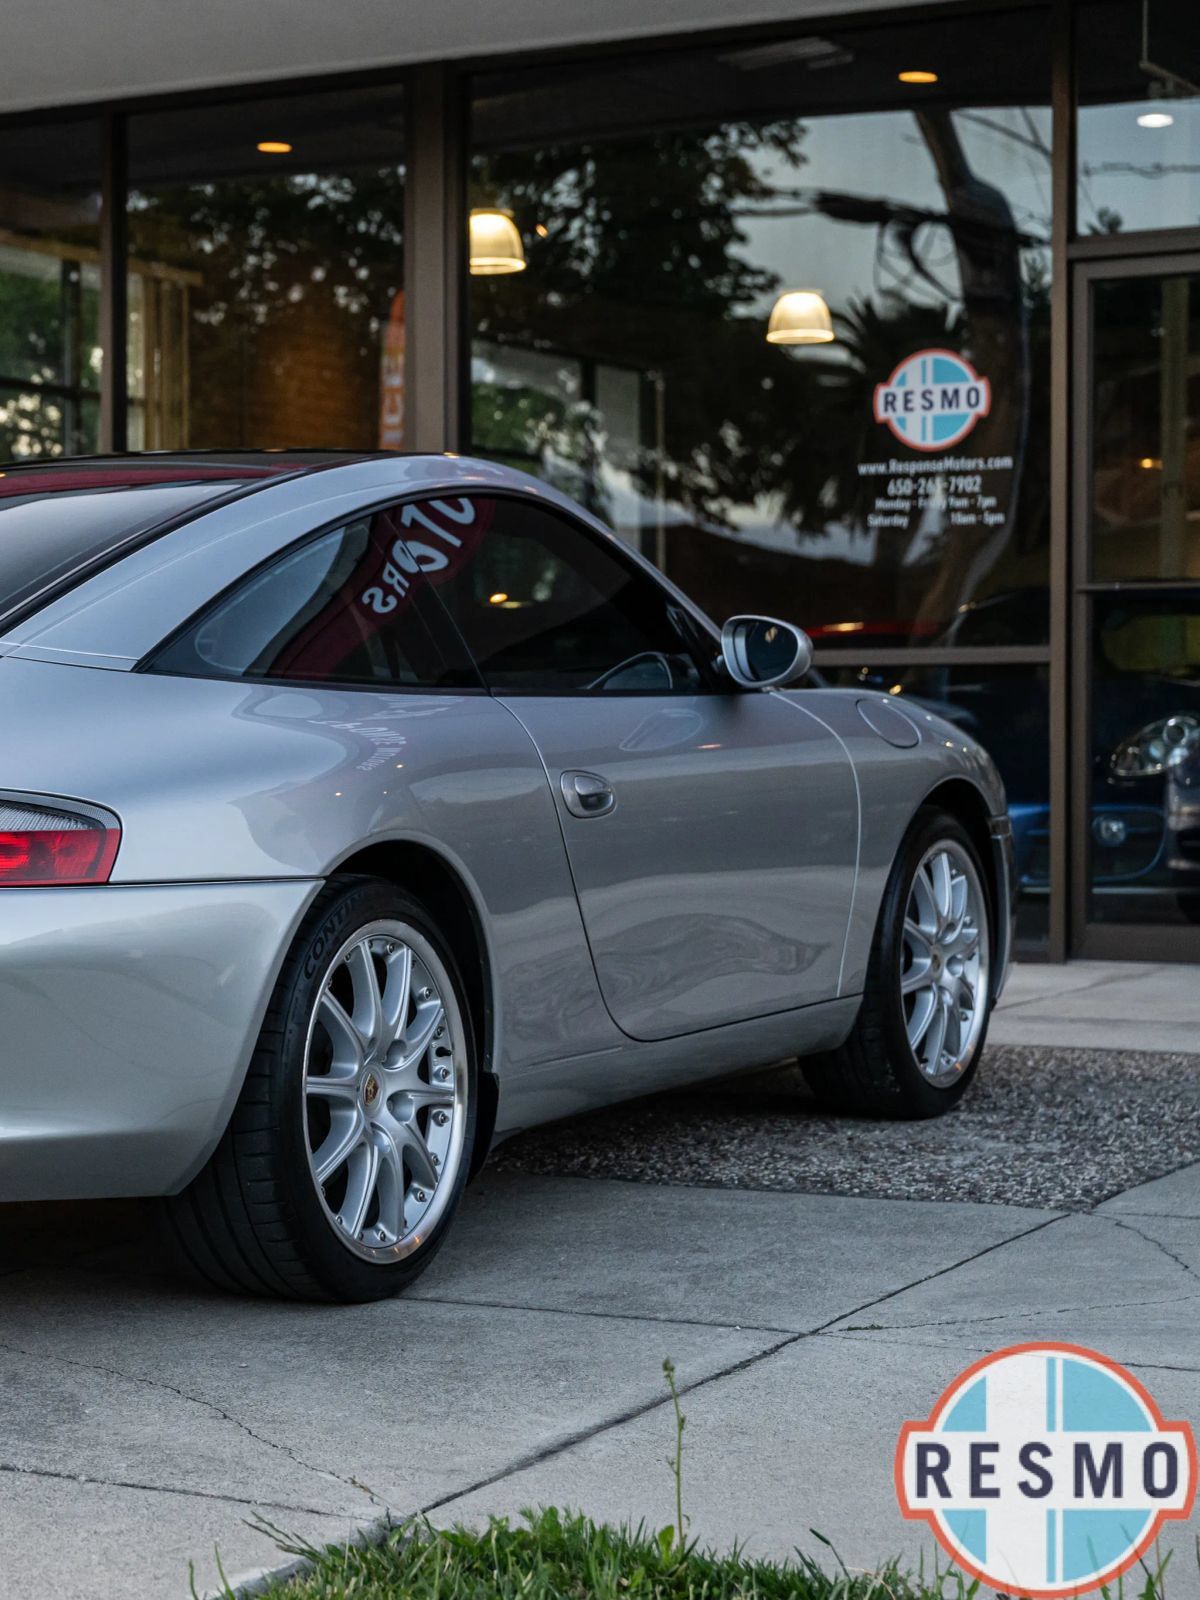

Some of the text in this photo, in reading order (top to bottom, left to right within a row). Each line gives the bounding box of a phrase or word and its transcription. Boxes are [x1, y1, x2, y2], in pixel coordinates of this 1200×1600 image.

[883, 386, 981, 413] RESMO
[857, 456, 1013, 476] www.ResponseMotors.com
[867, 514, 910, 529] Saturday
